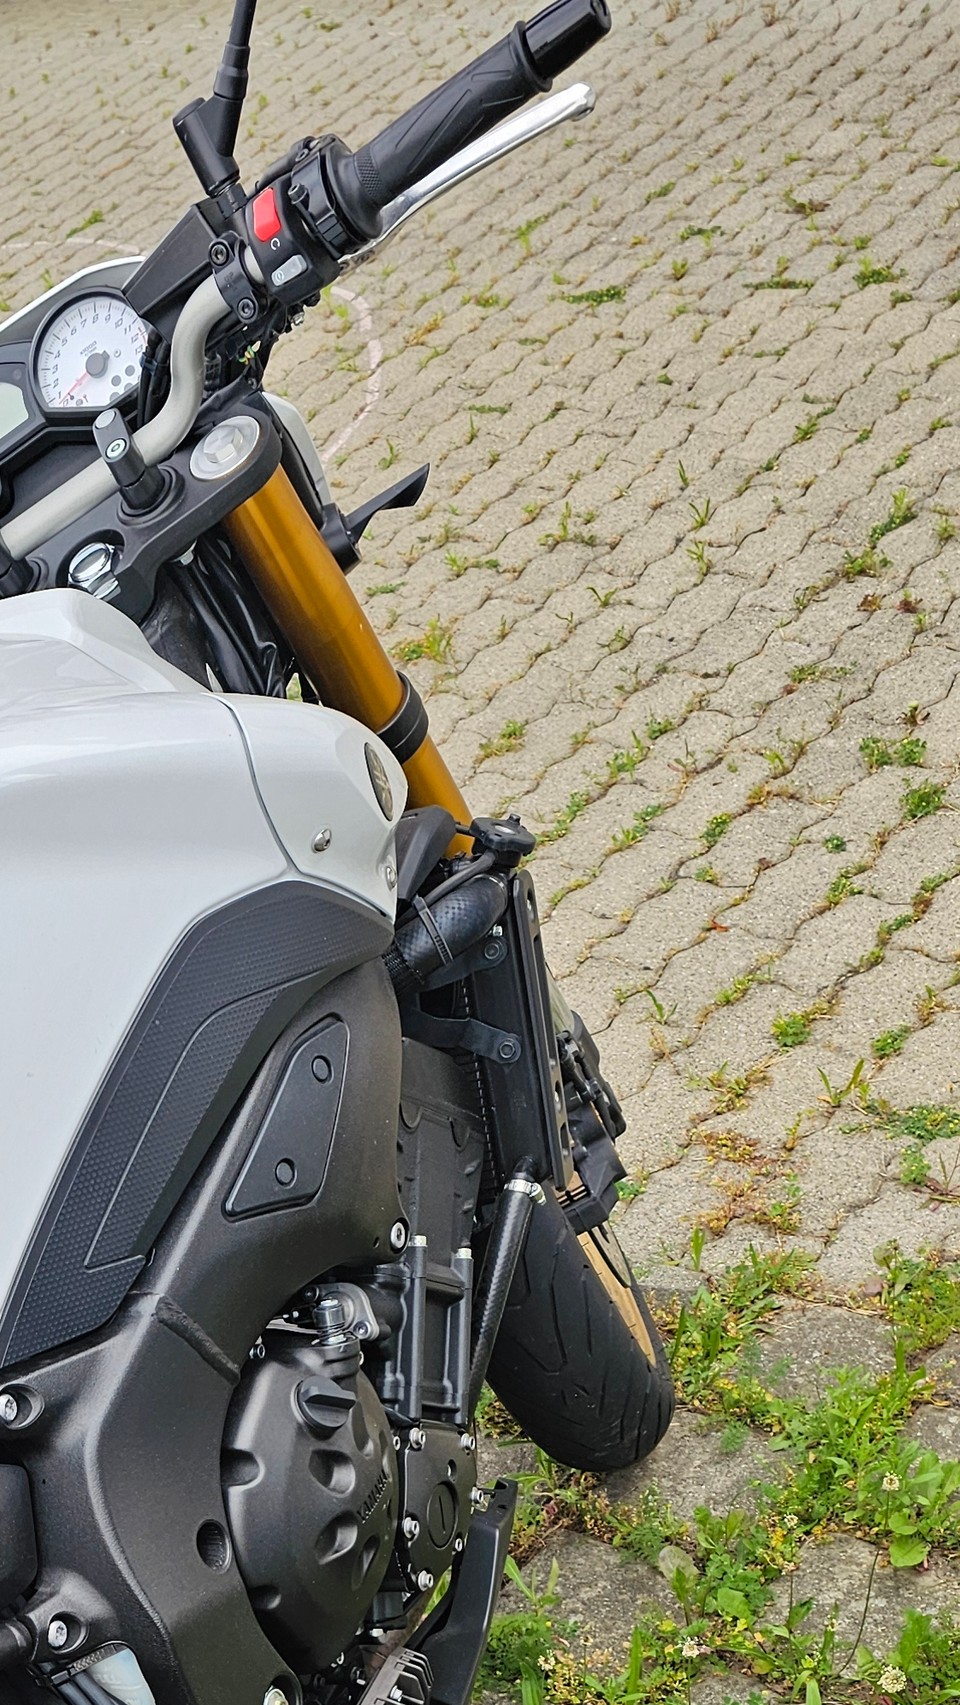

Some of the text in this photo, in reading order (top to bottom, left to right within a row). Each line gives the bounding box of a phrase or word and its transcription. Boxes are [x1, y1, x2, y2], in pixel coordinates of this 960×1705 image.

[92, 314, 99, 324] 8
[105, 314, 111, 323] 9
[80, 319, 87, 328] 7
[115, 318, 124, 329] 10
[70, 328, 77, 336] 6
[124, 325, 132, 335] 11
[61, 338, 68, 347] 5
[54, 350, 61, 359] 4
[52, 364, 58, 374] 3
[53, 378, 59, 389] 2
